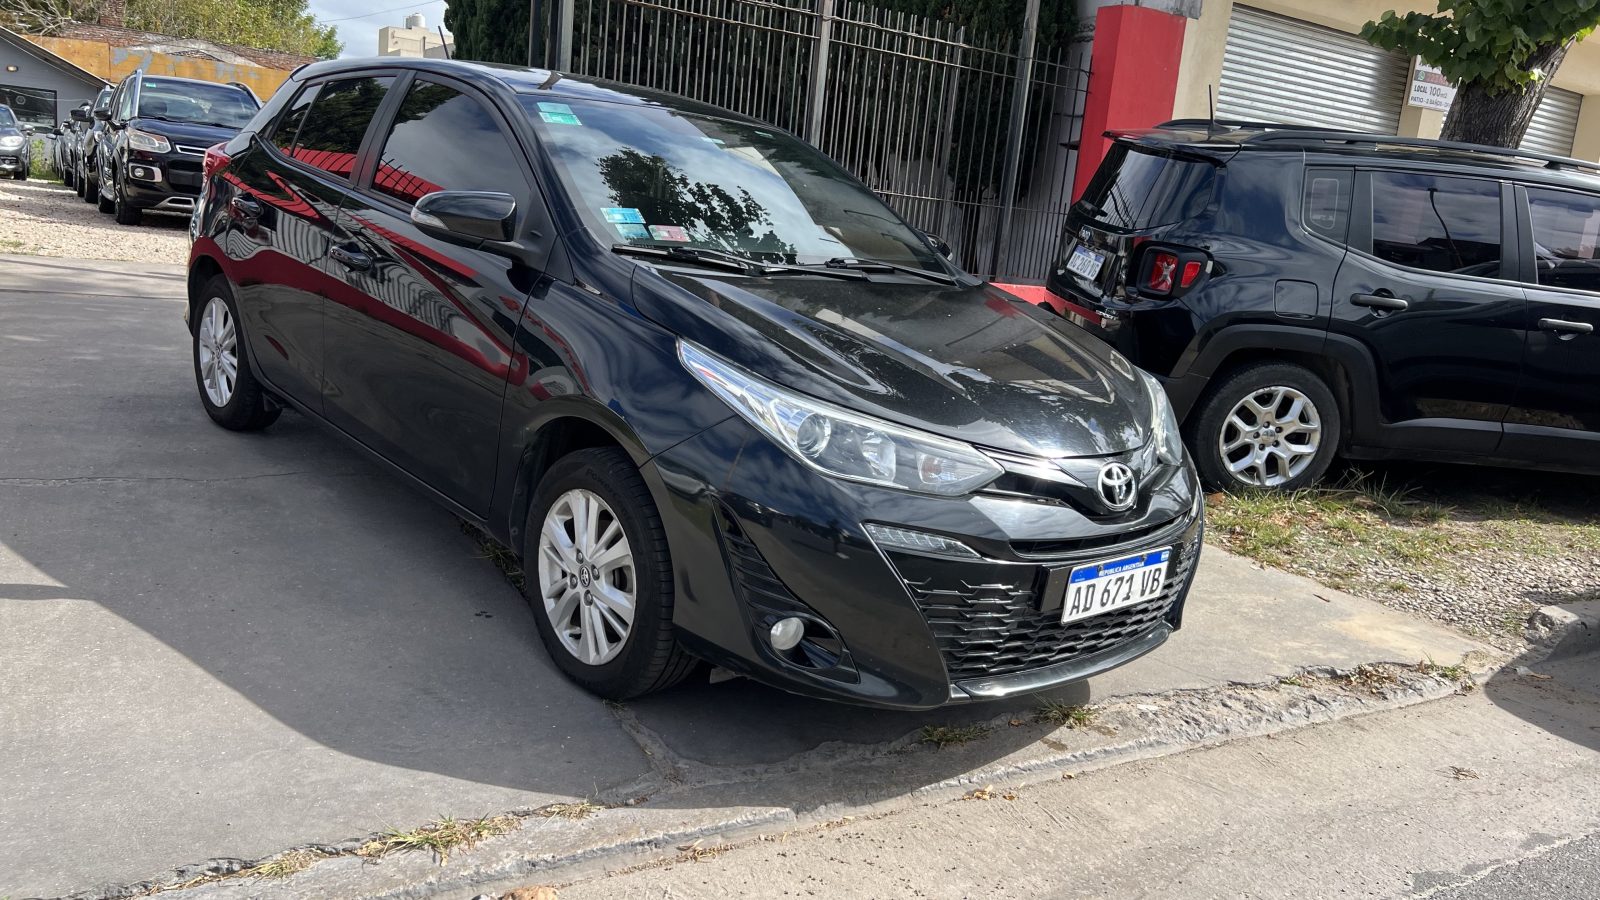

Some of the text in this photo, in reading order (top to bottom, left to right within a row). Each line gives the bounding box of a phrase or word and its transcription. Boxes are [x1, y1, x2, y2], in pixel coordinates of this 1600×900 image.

[1414, 85, 1427, 94] LOCAL
[1069, 567, 1162, 616] AD 671 VB
